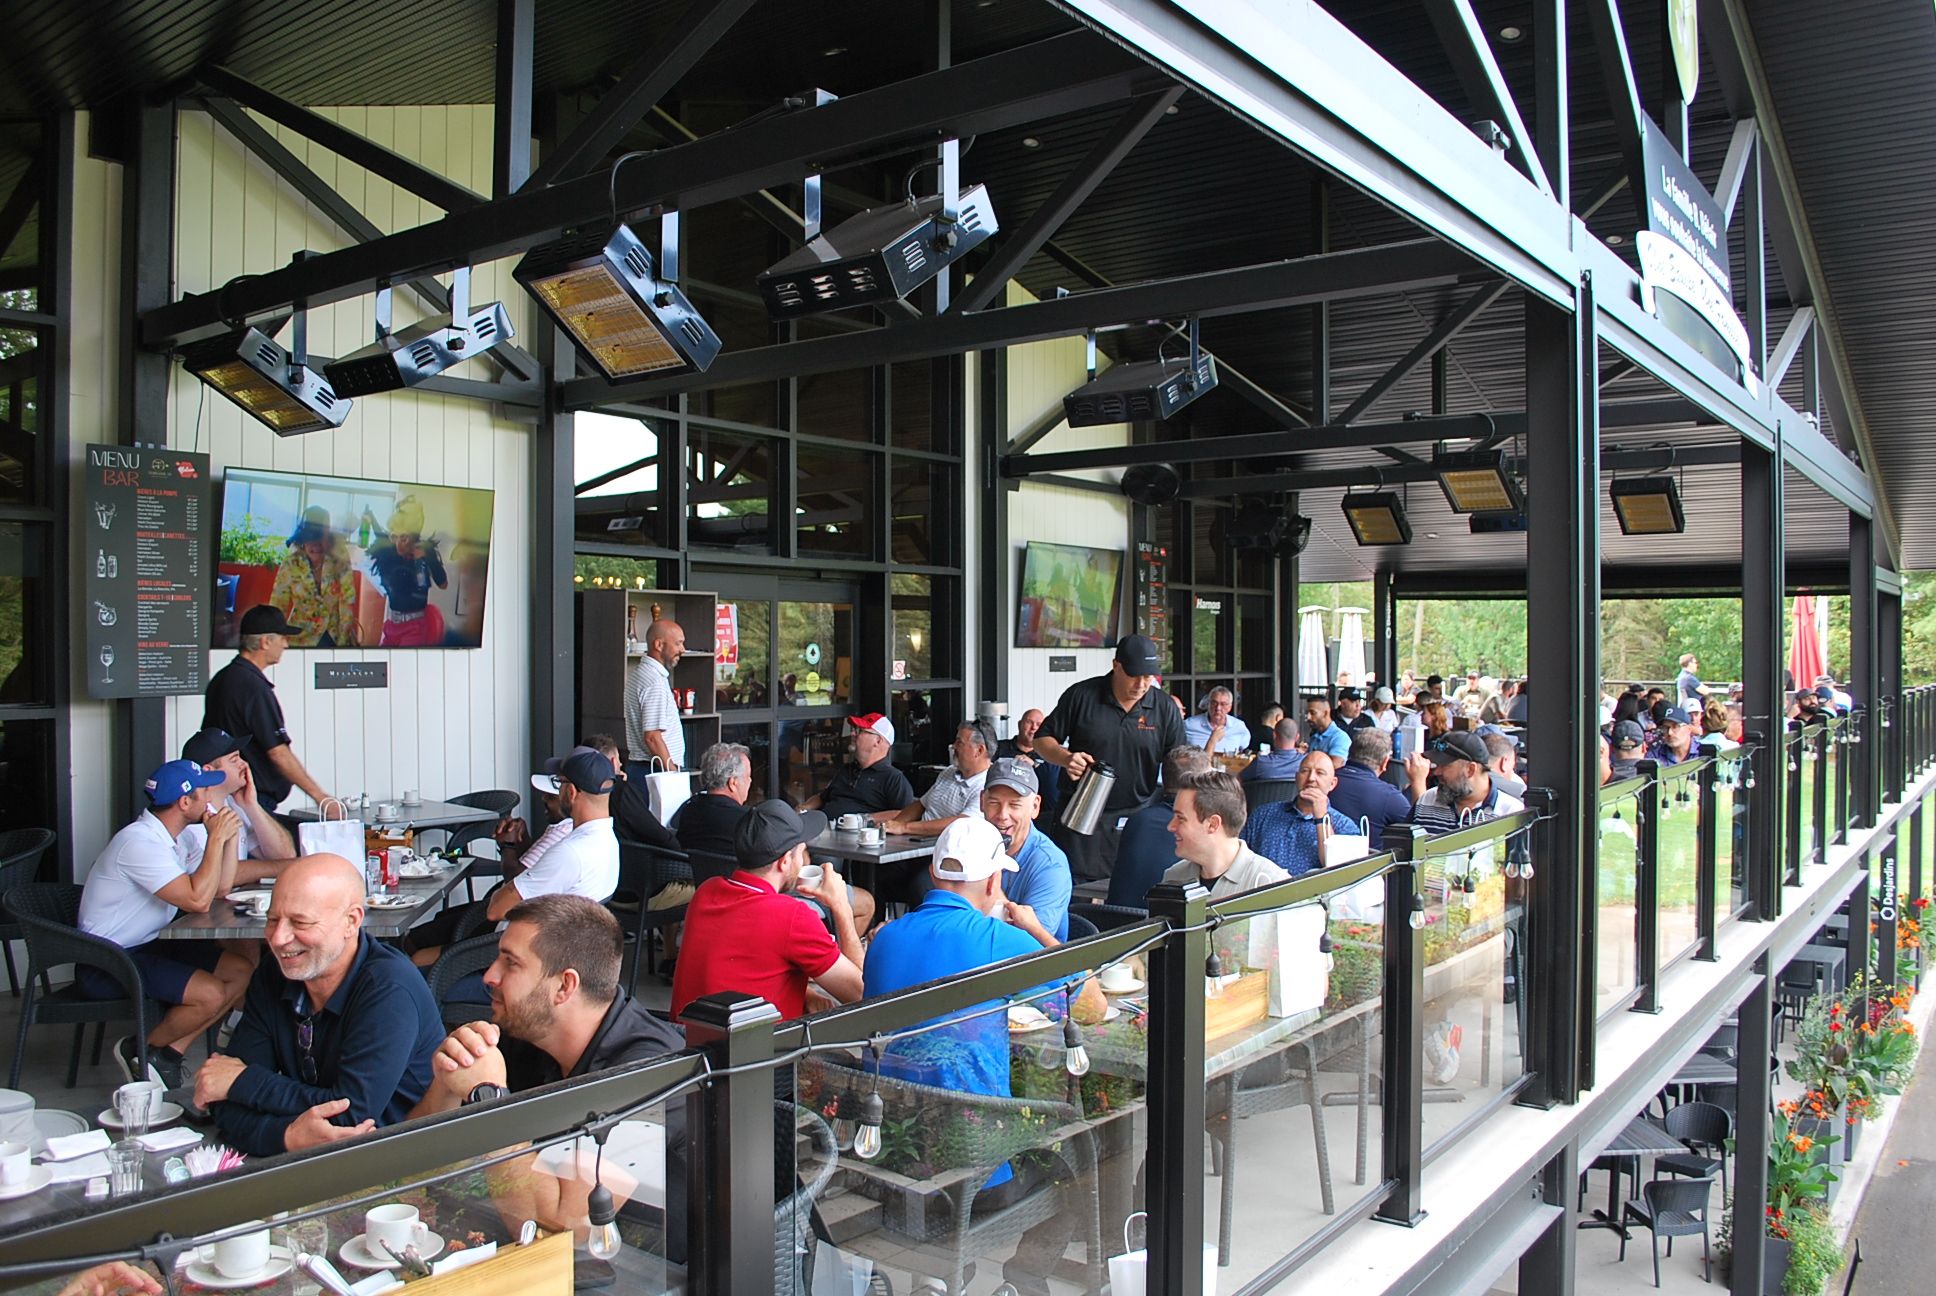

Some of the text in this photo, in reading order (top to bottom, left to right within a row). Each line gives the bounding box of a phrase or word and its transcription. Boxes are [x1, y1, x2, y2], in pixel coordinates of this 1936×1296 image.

[1661, 165, 1672, 198] La
[1671, 177, 1694, 223] famille
[1651, 197, 1670, 231] vous
[1670, 216, 1696, 259] souhaite
[1696, 238, 1703, 267] la
[92, 450, 140, 469] MENU
[104, 469, 140, 487] BAR
[1882, 857, 1896, 906] Desjardins
